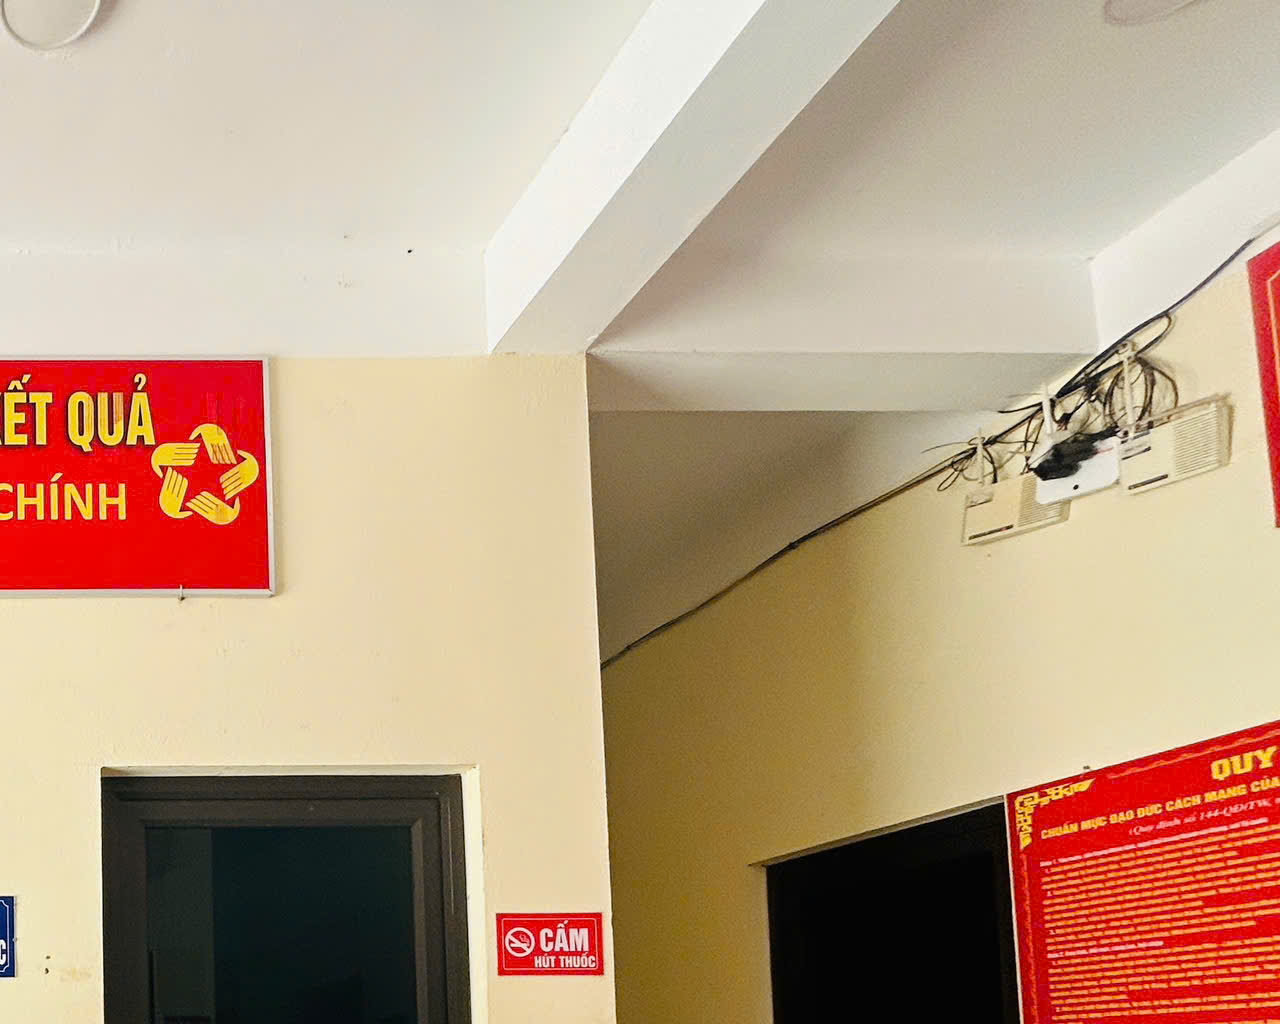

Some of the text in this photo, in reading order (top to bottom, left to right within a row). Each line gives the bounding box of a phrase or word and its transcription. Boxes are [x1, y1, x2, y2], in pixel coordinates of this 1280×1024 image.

[67, 373, 155, 452] QUẢ
[1211, 745, 1277, 780] QUY
[540, 920, 590, 952] CẤM
[534, 952, 596, 968] HÚT THUỐC
